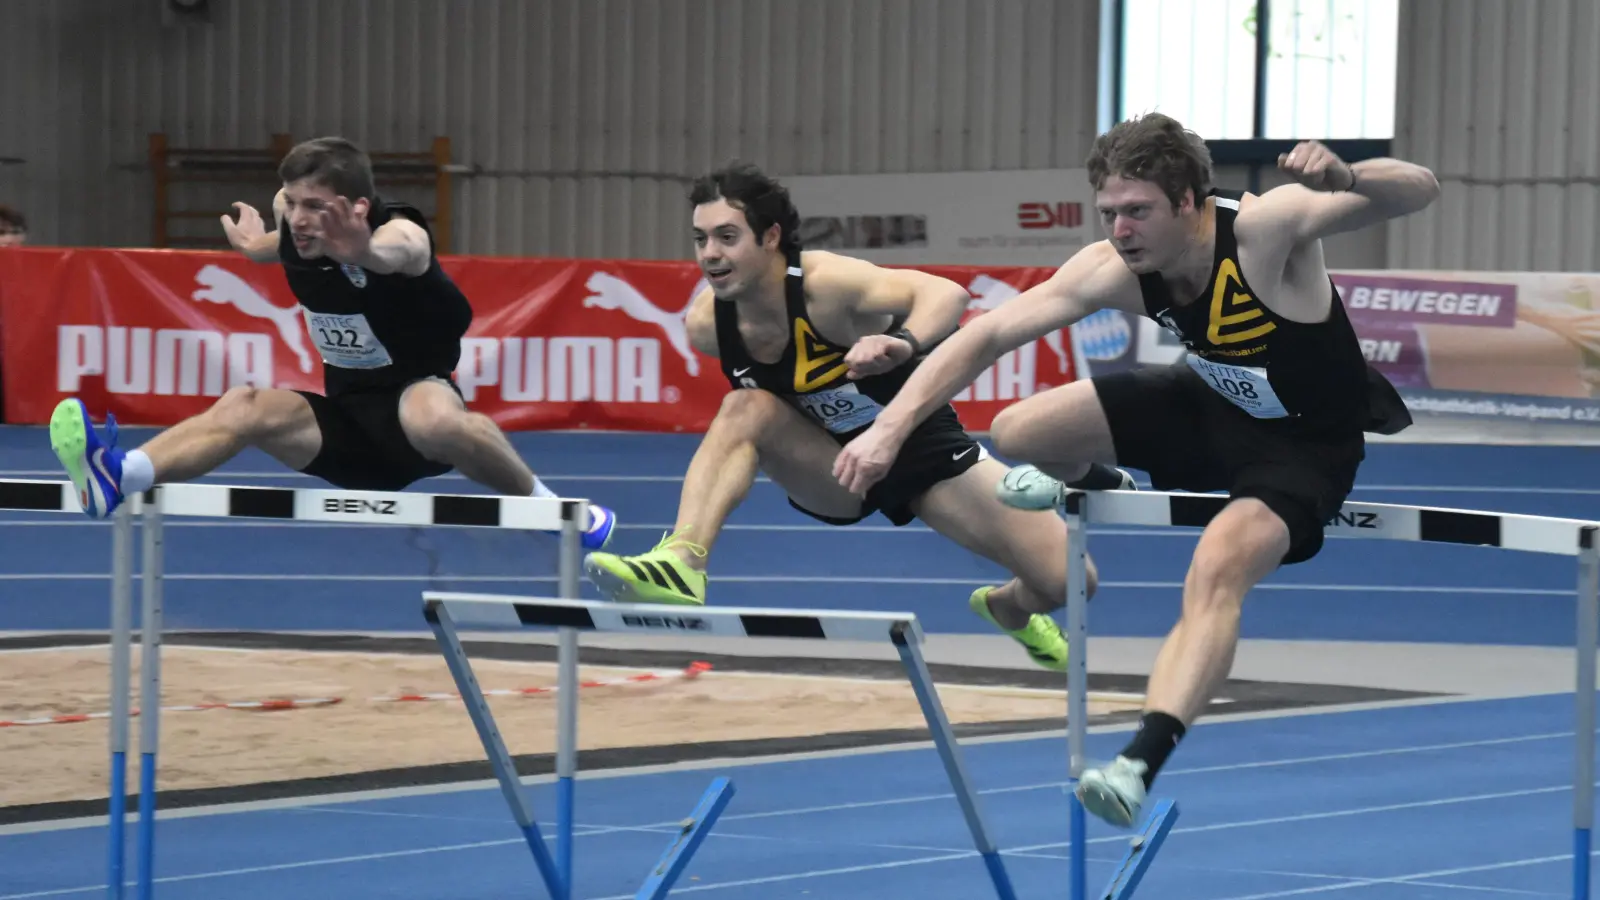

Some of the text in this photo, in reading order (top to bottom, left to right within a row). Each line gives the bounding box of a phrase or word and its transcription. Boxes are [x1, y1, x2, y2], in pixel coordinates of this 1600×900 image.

[1350, 286, 1501, 316] BEWEGEN
[311, 315, 357, 329] HEITEC
[319, 328, 363, 348] 122
[58, 325, 272, 396] PUMA
[457, 337, 661, 402] PUMA
[1197, 359, 1255, 382] HEITEC
[1209, 373, 1258, 399] 108
[806, 399, 854, 422] 109
[324, 498, 398, 514] BENZ
[1328, 511, 1379, 529] NZ
[621, 614, 710, 631] BENZ
